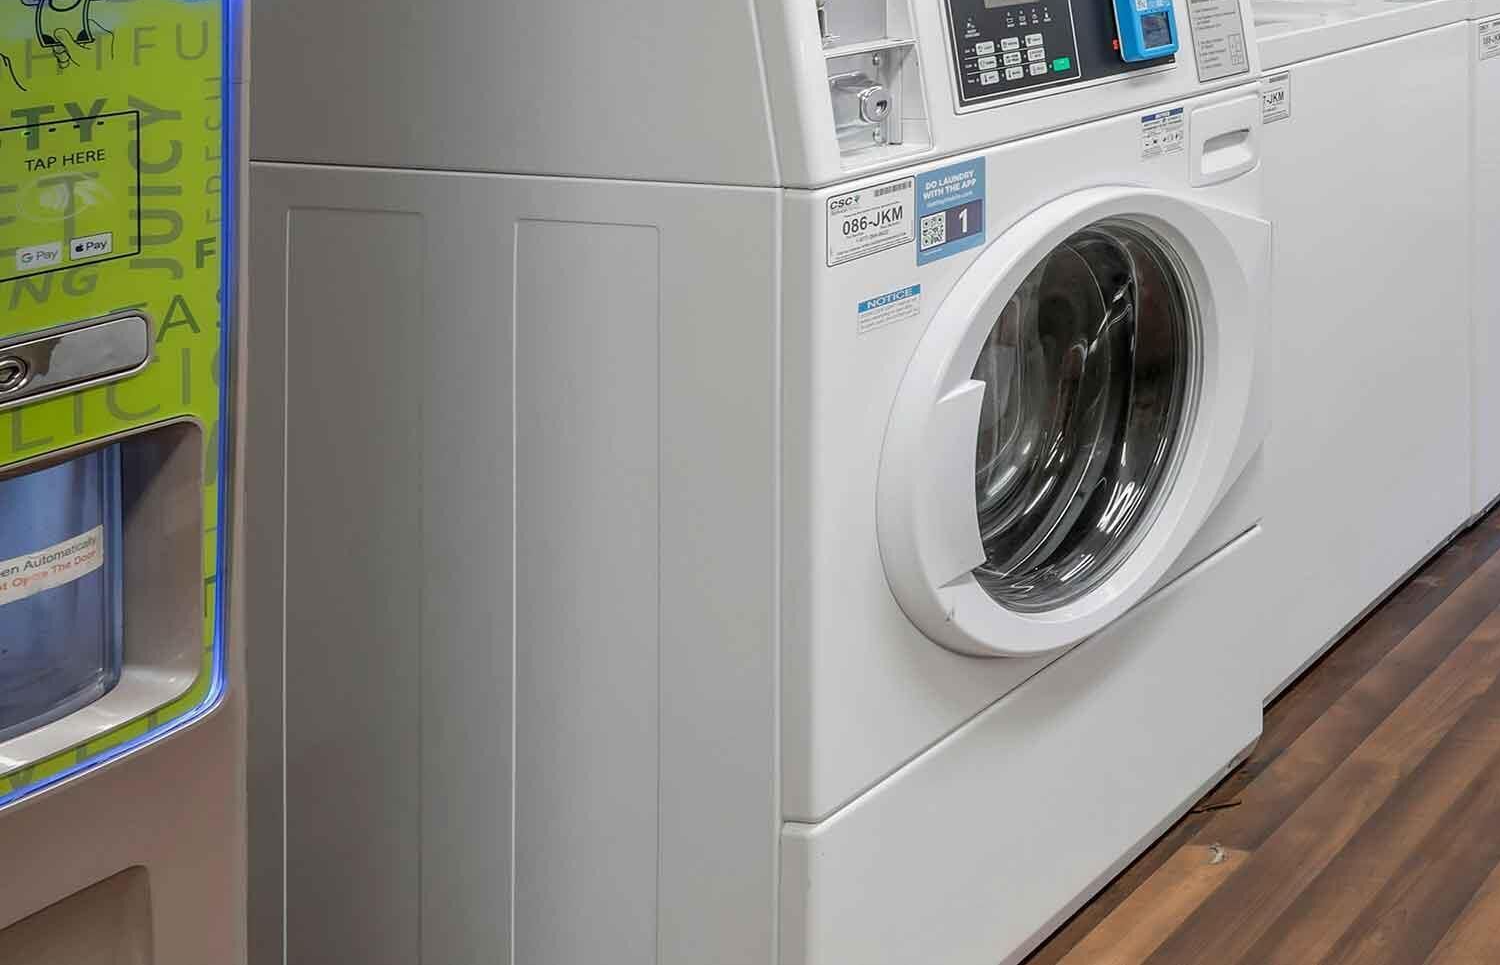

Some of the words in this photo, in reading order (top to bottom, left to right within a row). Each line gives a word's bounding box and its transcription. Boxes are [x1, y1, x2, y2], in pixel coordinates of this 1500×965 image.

[24, 156, 57, 172] TAP
[62, 148, 106, 167] HERE
[923, 187, 944, 199] WITH
[945, 182, 961, 193] THE
[962, 178, 977, 189] APP
[925, 180, 937, 190] DO
[939, 170, 975, 186] LAUNDRY
[830, 196, 853, 210] CSC
[842, 205, 903, 236] 086-JKM
[958, 208, 968, 233] 1
[36, 249, 59, 263] Pay
[85, 239, 108, 253] Pay
[867, 288, 912, 308] NOTICE
